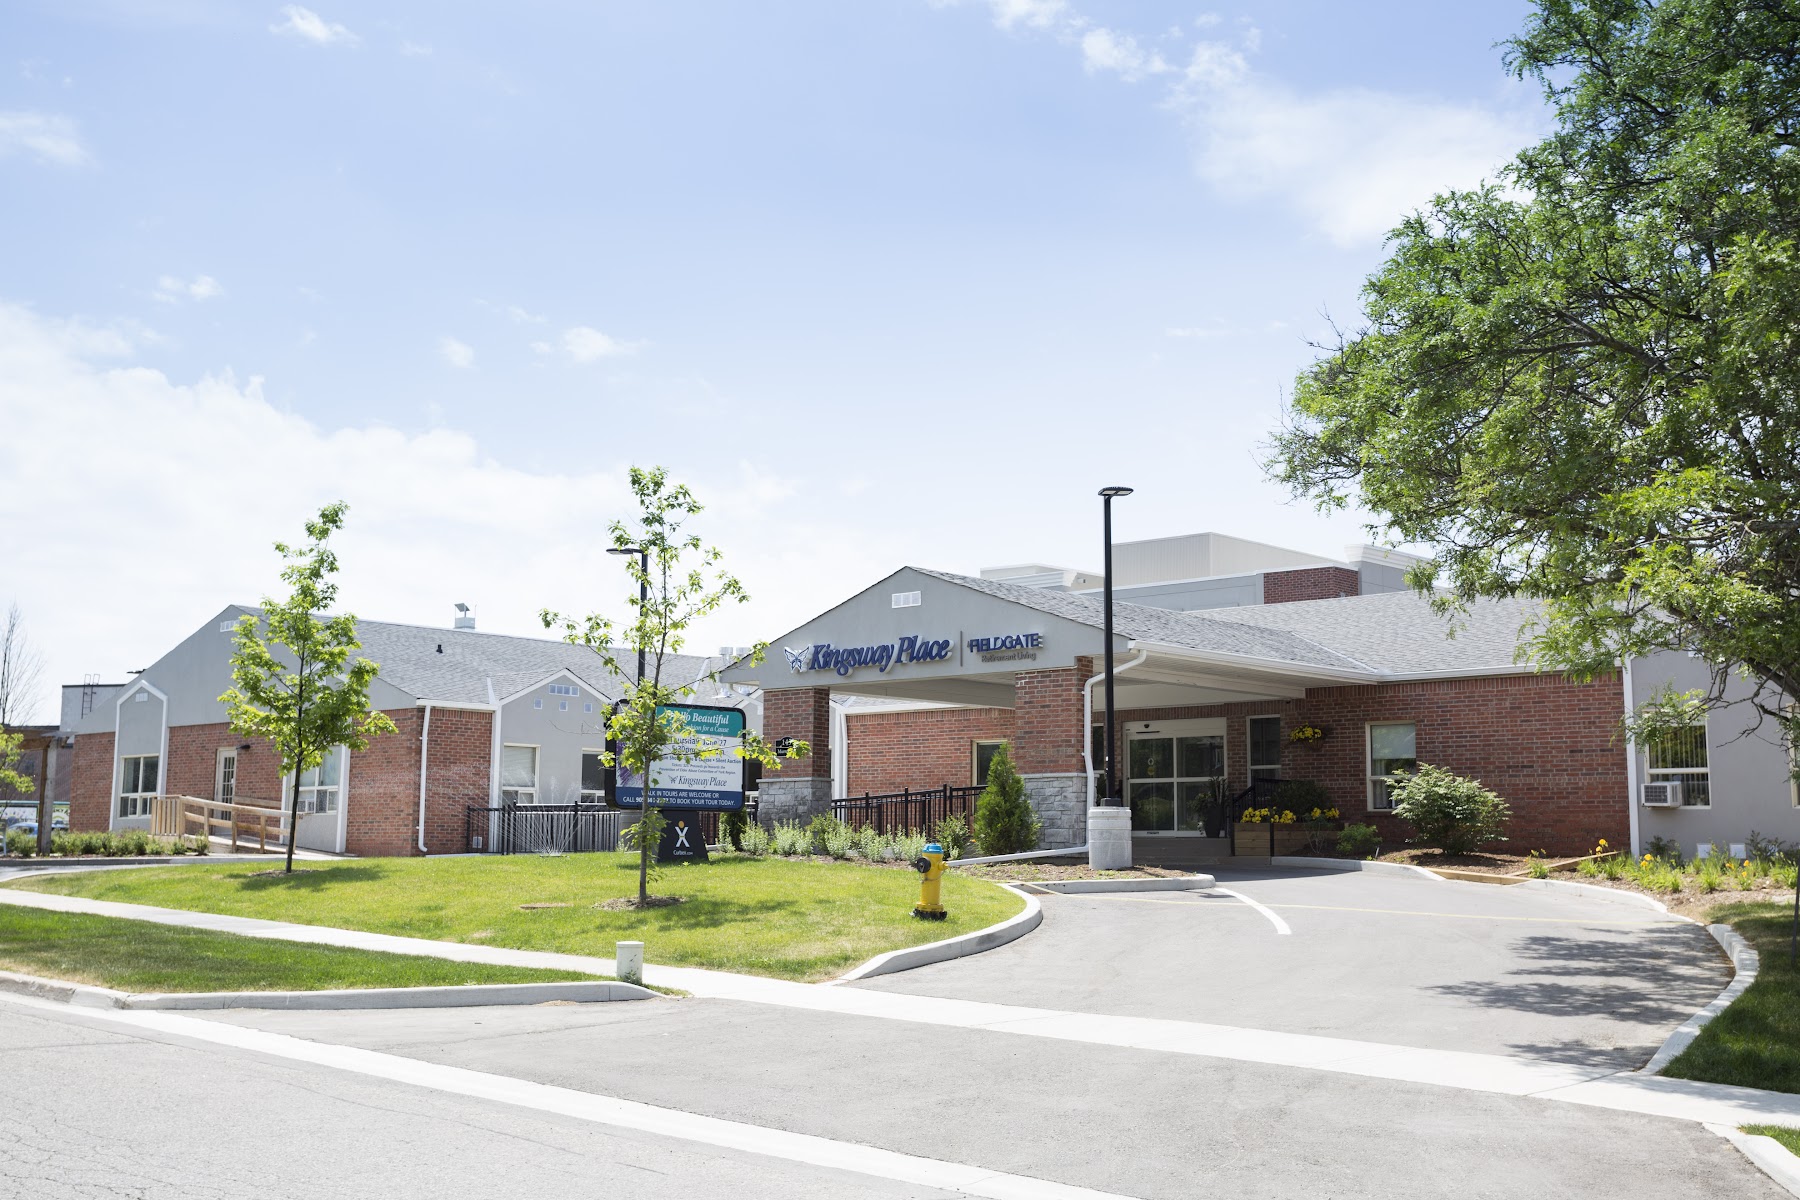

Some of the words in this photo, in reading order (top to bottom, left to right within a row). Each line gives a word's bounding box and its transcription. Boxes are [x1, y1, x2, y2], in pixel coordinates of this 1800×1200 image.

[969, 633, 1041, 653] FIELDGATE
[809, 644, 896, 676] Kingsway
[895, 635, 951, 664] Place
[981, 653, 1016, 662] Retirement
[1017, 651, 1036, 661] Living
[692, 713, 729, 726] Beautiful
[678, 776, 709, 788] Kingsway
[710, 776, 727, 786] Place
